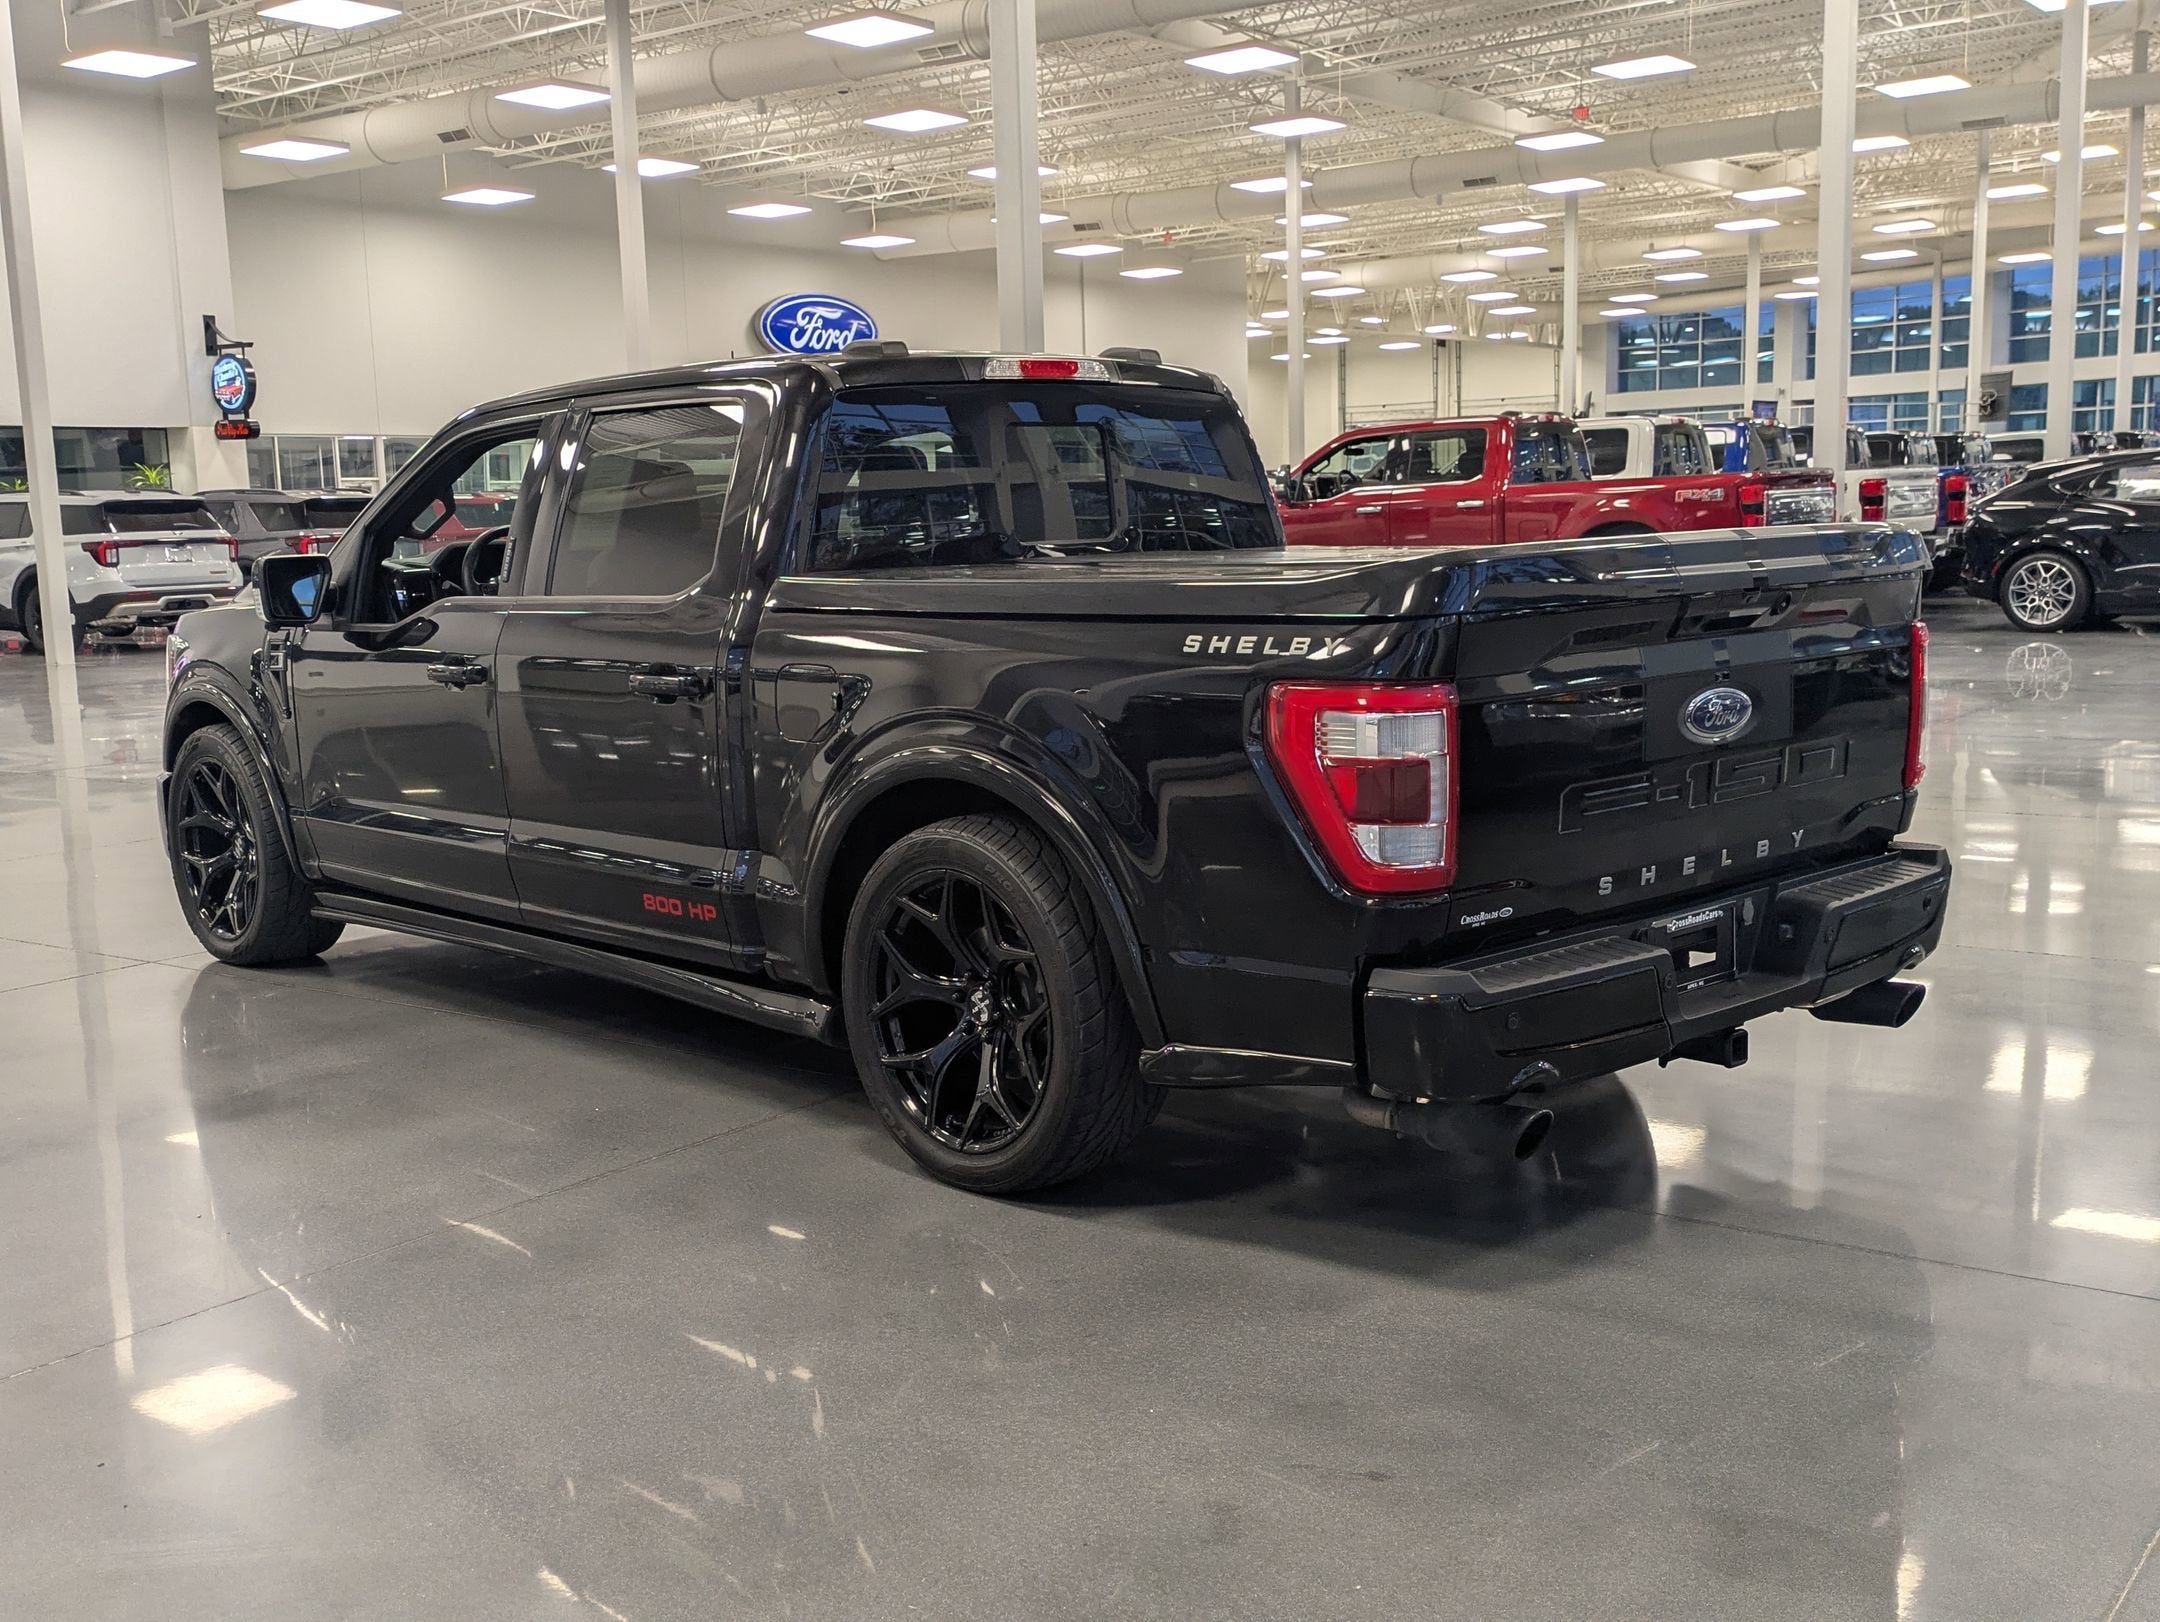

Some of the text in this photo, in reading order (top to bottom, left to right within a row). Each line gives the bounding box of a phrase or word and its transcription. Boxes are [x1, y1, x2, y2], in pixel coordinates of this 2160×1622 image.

[789, 306, 860, 350] Ford
[1674, 488, 1724, 503] FX4
[1182, 634, 1345, 657] SHELBY
[1704, 698, 1741, 728] Ford
[1558, 736, 1850, 834] F-150
[1598, 829, 1804, 896] SHELBY
[642, 893, 717, 920] 800 HP
